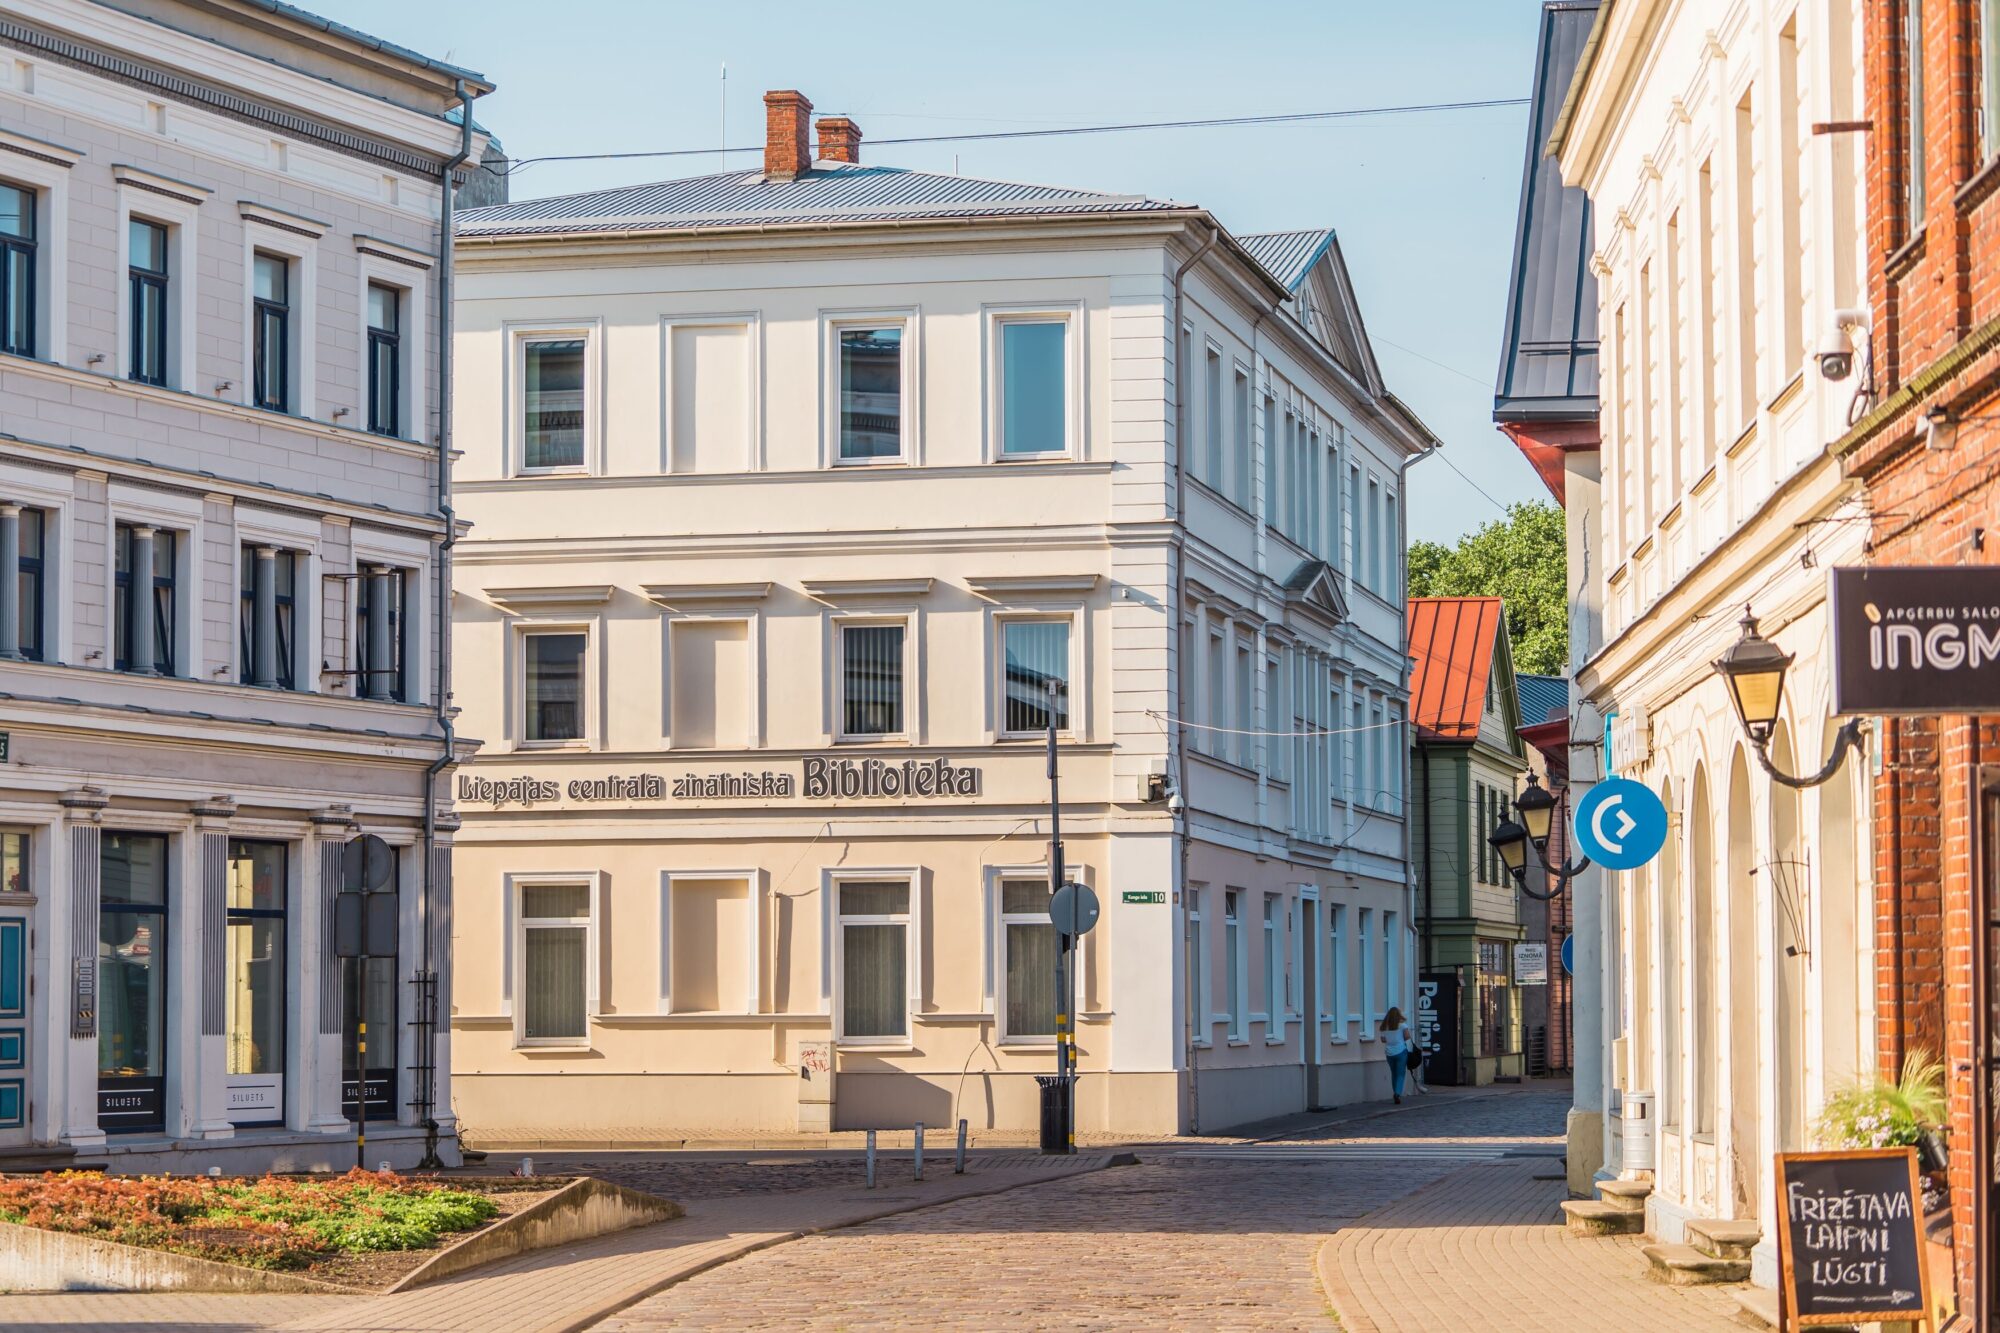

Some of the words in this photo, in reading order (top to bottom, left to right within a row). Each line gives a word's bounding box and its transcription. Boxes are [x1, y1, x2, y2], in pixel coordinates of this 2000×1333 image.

[1886, 606, 1955, 622] APĢĒRBU
[458, 775, 556, 806] Liepājas
[567, 773, 661, 799] centrālā
[671, 771, 791, 798] zinātniskā
[802, 757, 979, 797] Bibliotēka
[1154, 892, 1164, 903] 10
[1418, 981, 1440, 1052] Pellini
[347, 1087, 377, 1097] SILETS
[106, 1097, 142, 1107] SILUETS
[232, 1093, 264, 1103] SILUETS
